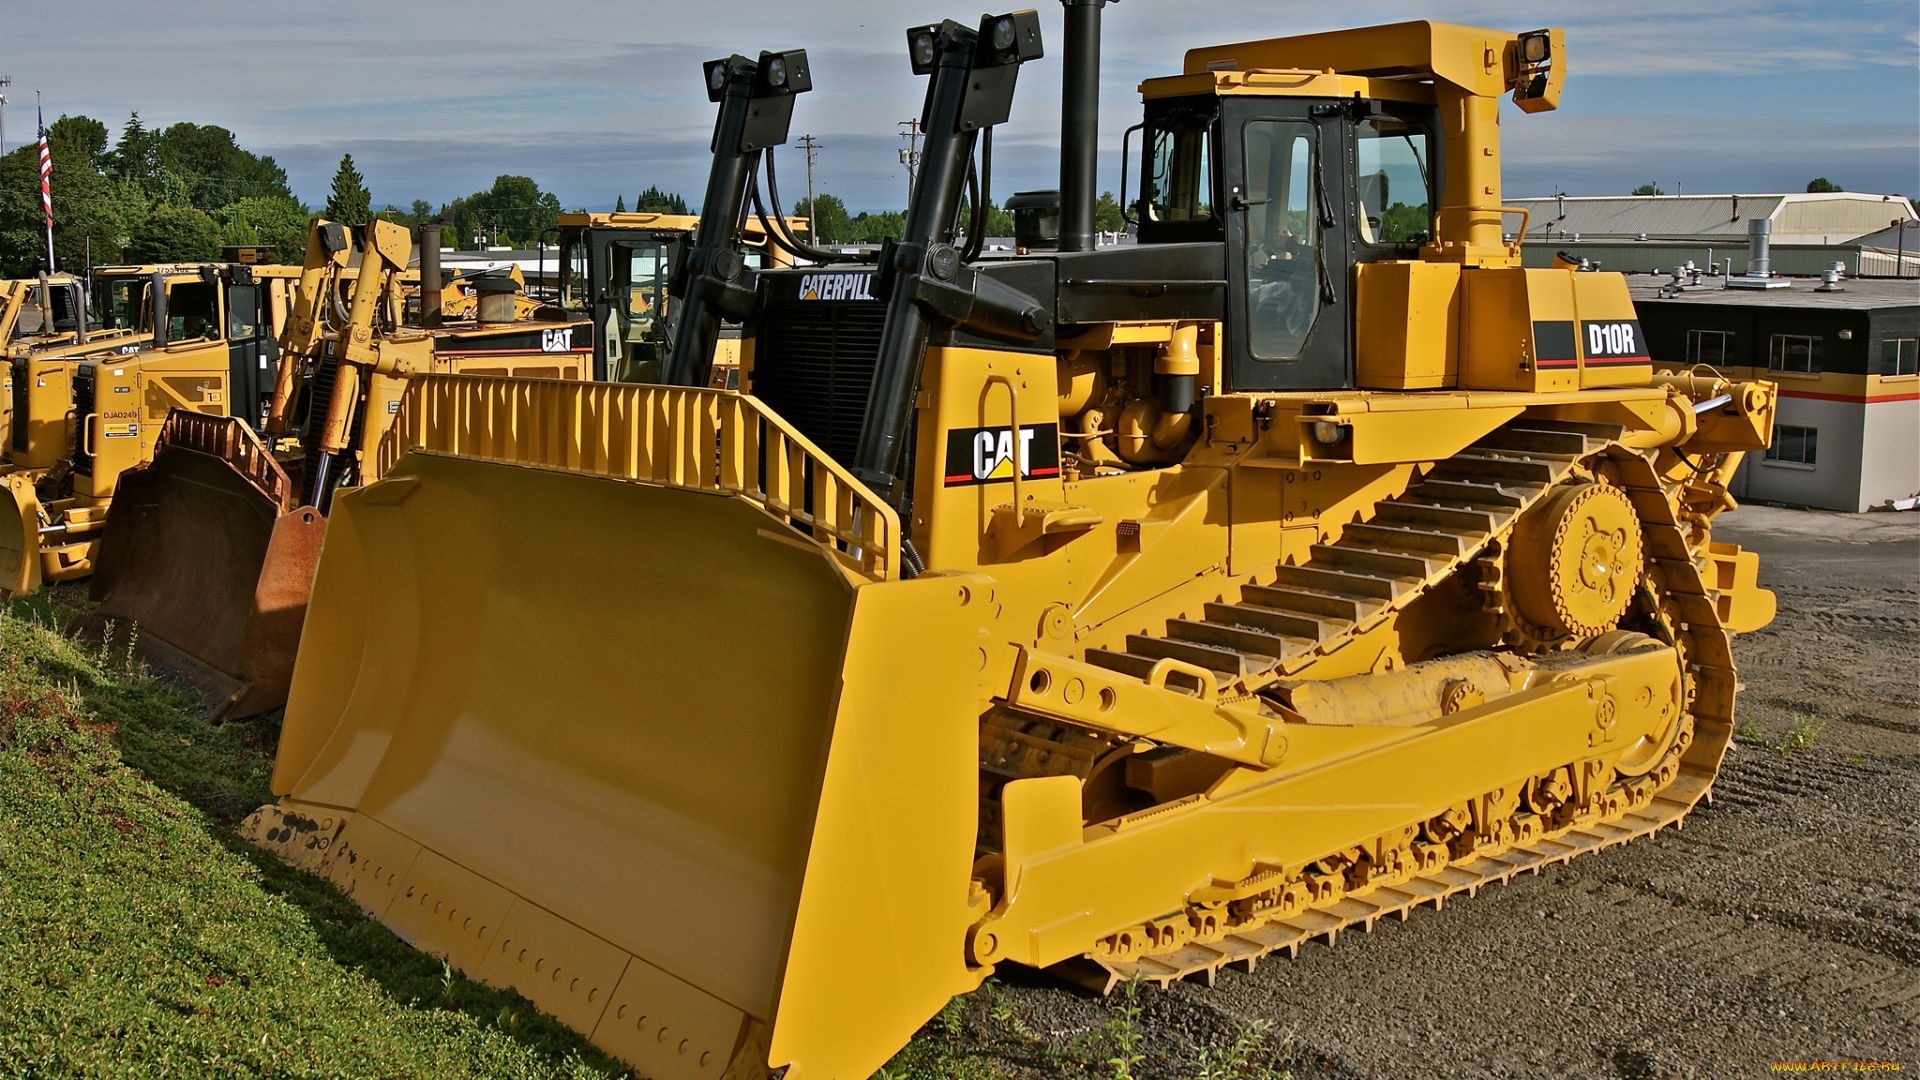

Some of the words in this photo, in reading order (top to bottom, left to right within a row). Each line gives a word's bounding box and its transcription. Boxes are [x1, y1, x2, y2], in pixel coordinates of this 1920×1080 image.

[799, 274, 876, 300] CATERPILL
[542, 328, 573, 352] CAT
[1588, 323, 1636, 355] D10R
[973, 428, 1035, 480] CAT
